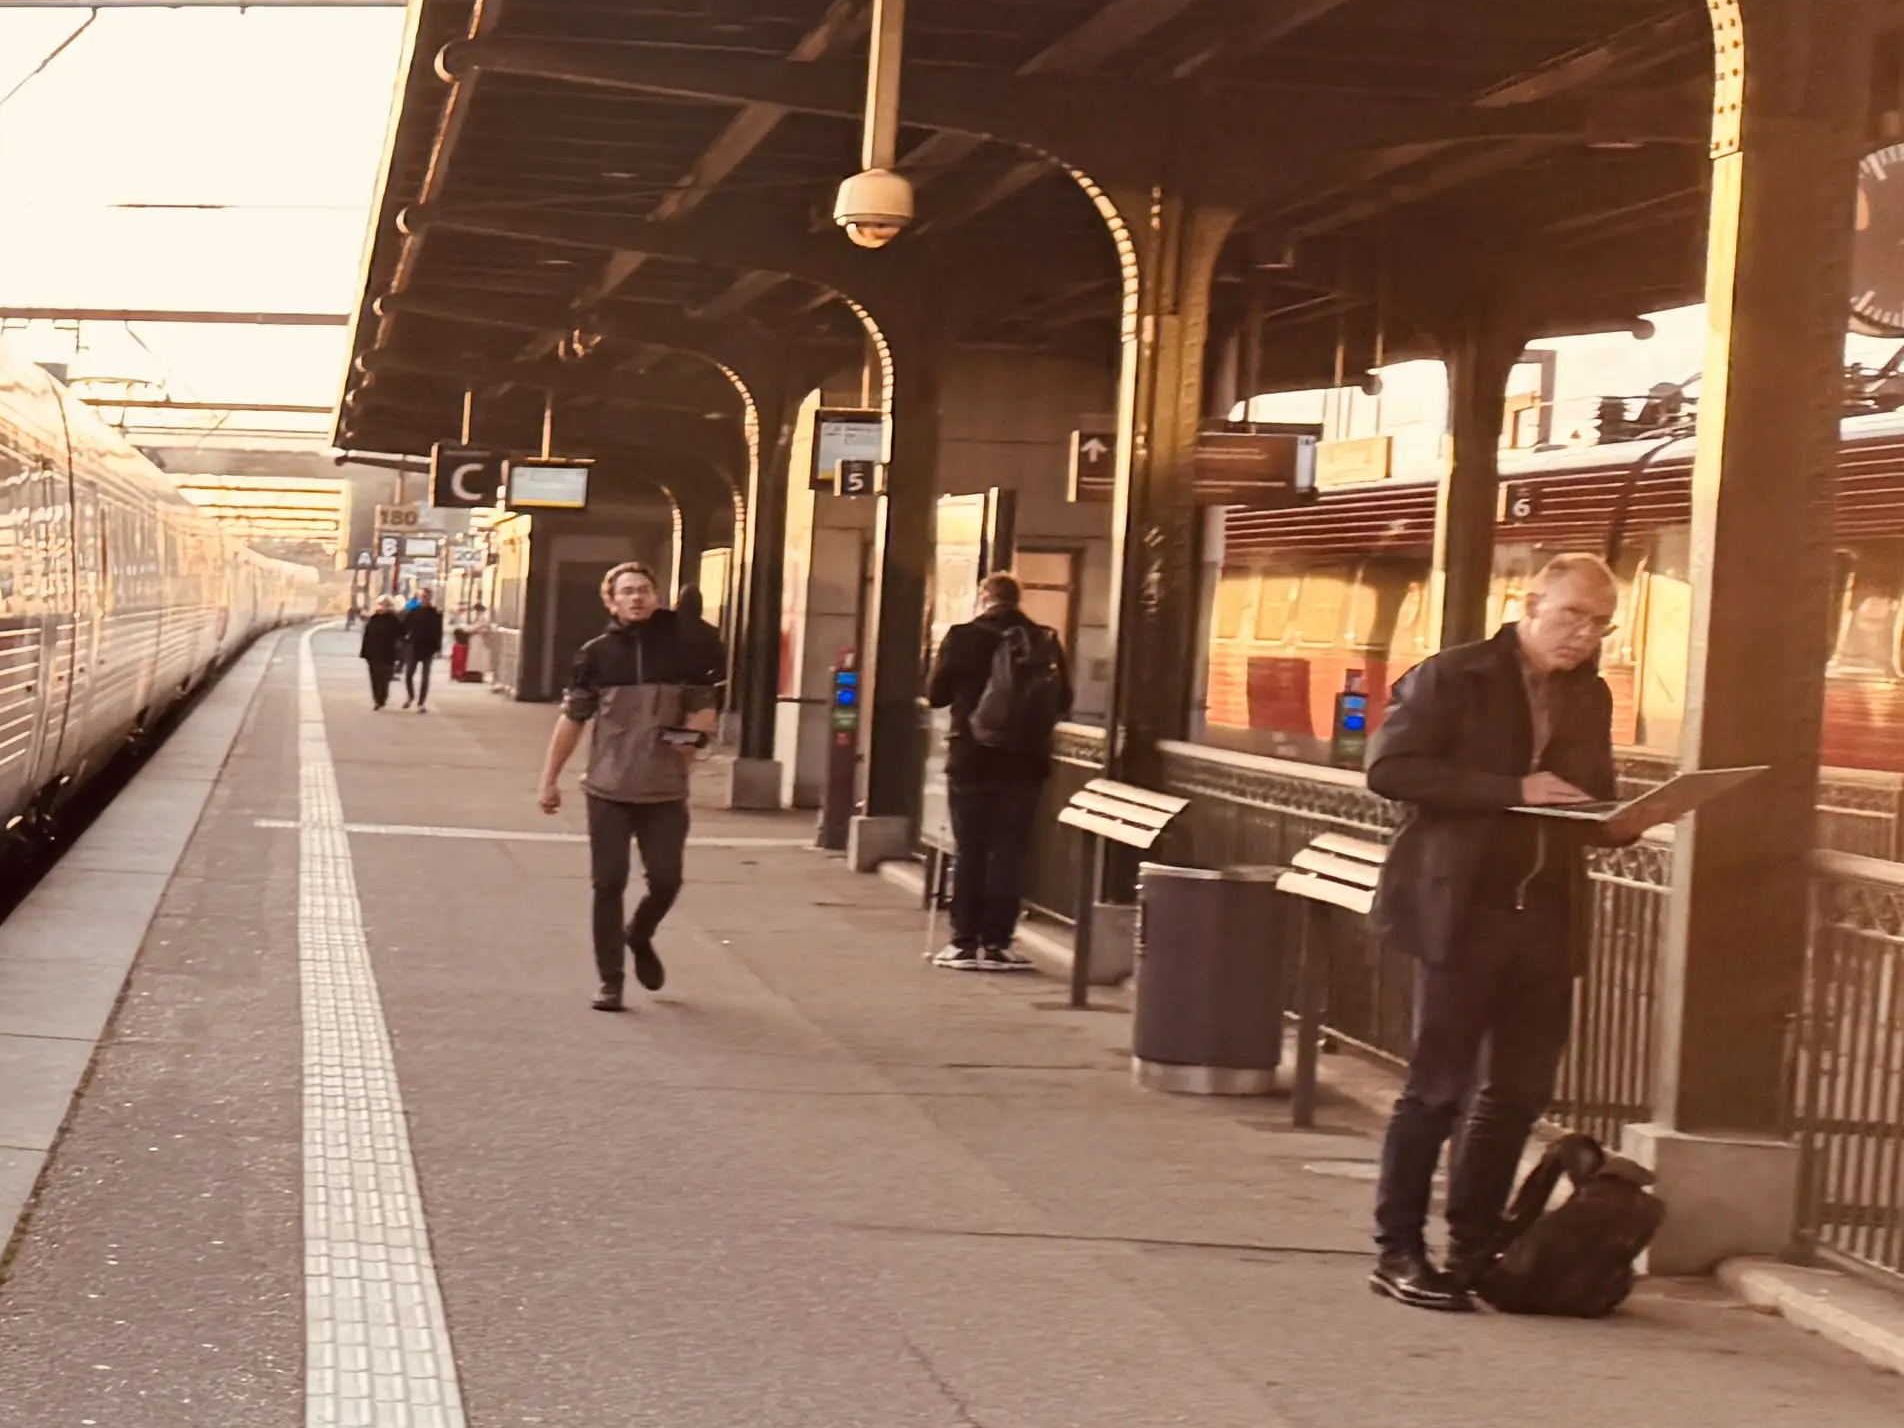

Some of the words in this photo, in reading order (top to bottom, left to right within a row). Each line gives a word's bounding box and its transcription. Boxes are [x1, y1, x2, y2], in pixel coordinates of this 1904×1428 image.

[451, 463, 484, 501] C
[847, 472, 864, 492] 5
[1513, 498, 1531, 517] 6
[381, 509, 418, 526] 180
[357, 551, 372, 566] A
